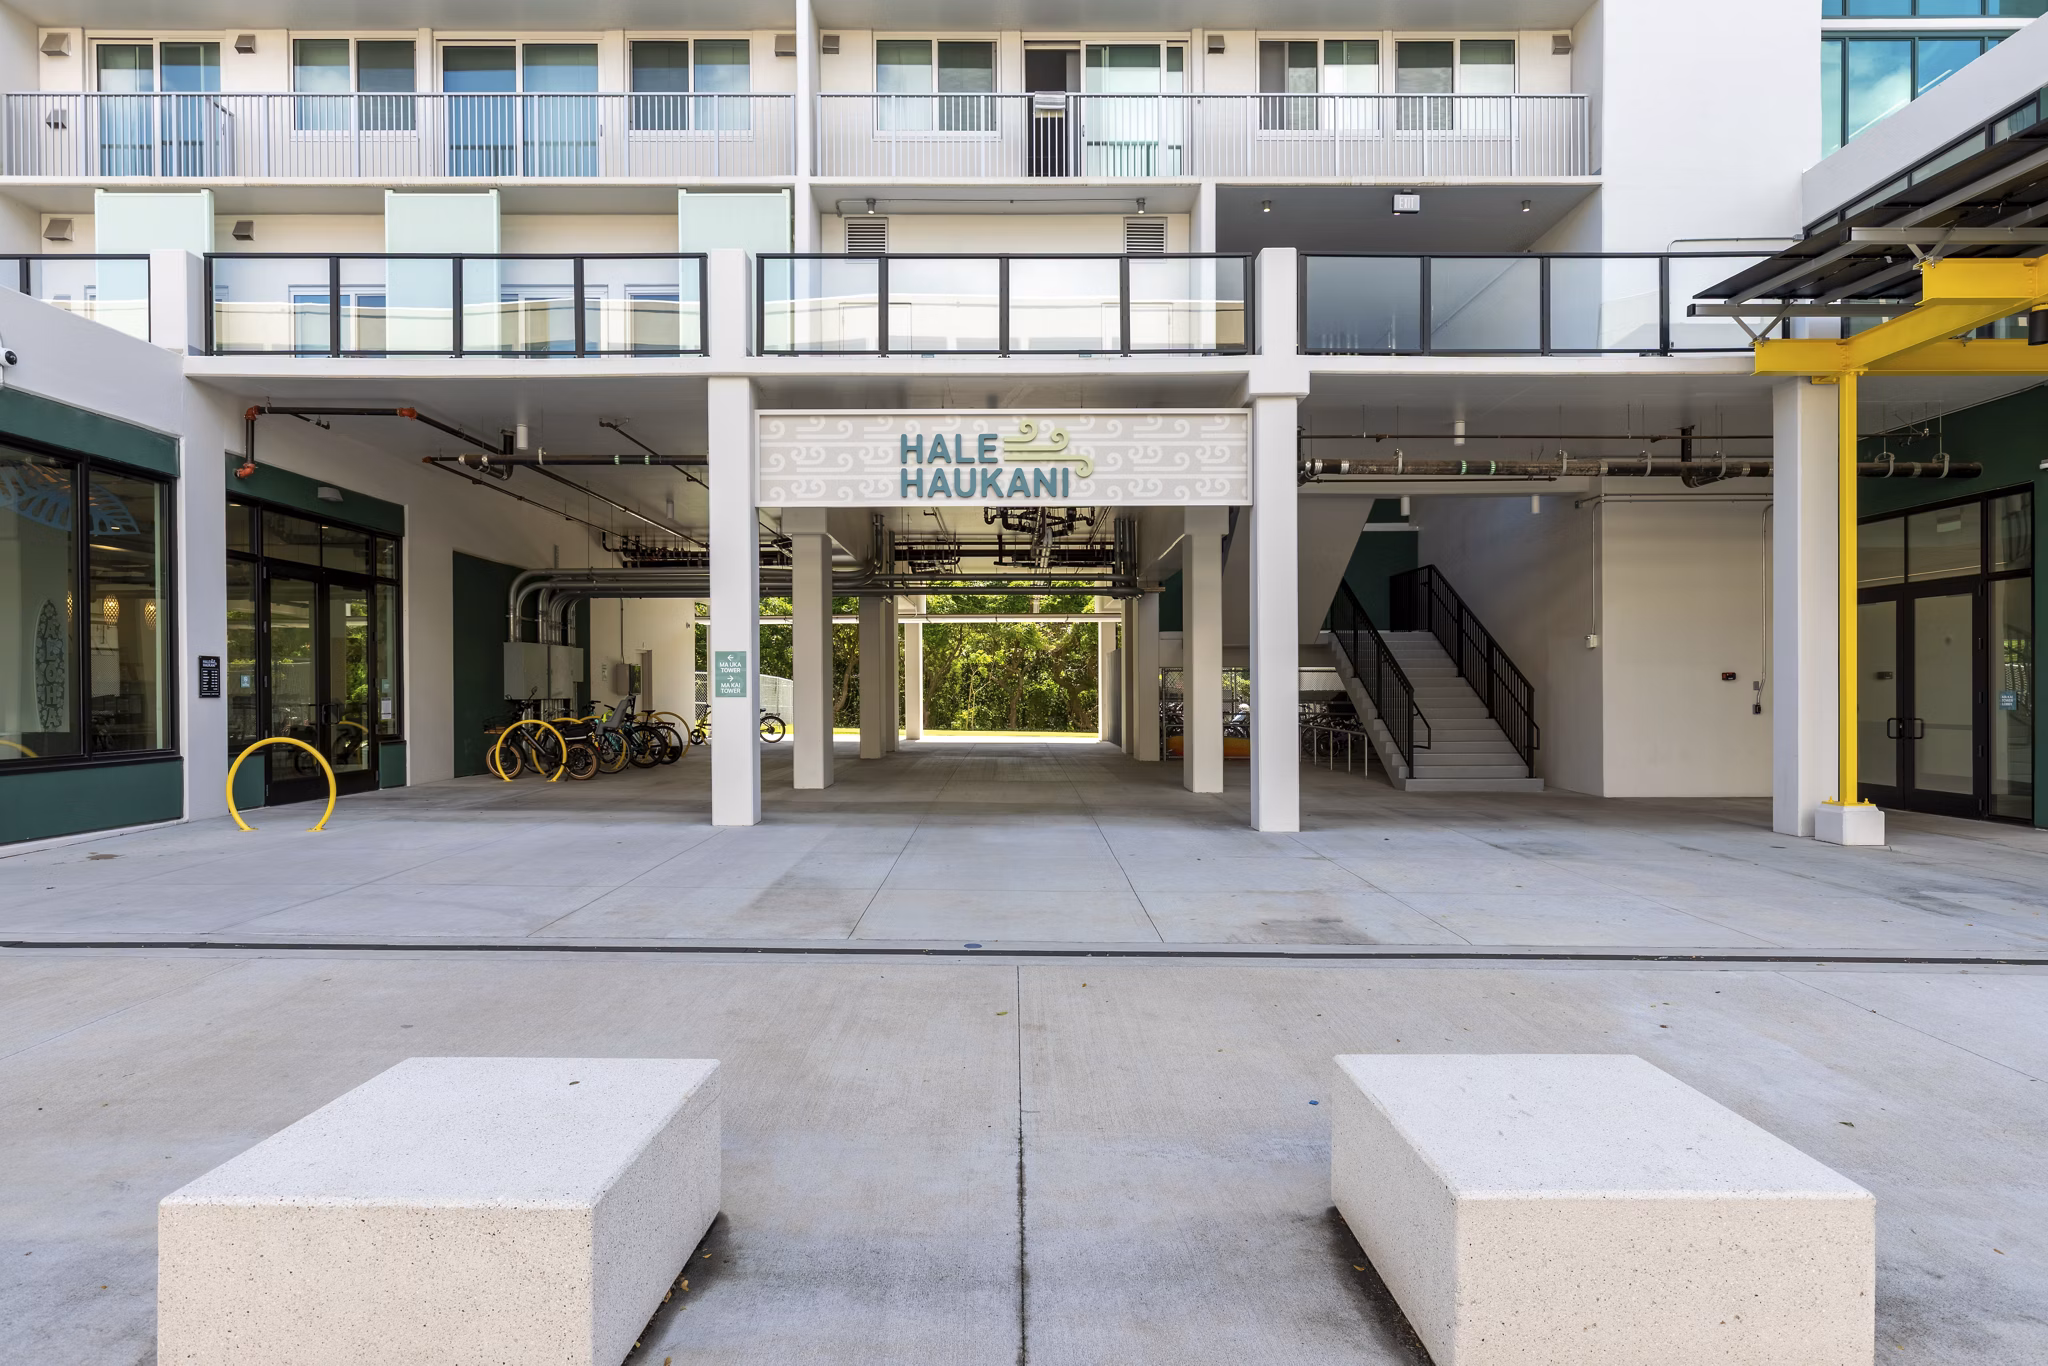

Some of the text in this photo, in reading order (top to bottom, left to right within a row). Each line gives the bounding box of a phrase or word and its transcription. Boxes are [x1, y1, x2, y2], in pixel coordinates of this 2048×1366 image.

[1399, 197, 1415, 209] EXIT
[901, 433, 998, 464] HALE
[901, 467, 1069, 498] HAUKANI
[44, 619, 60, 727] ALOHA
